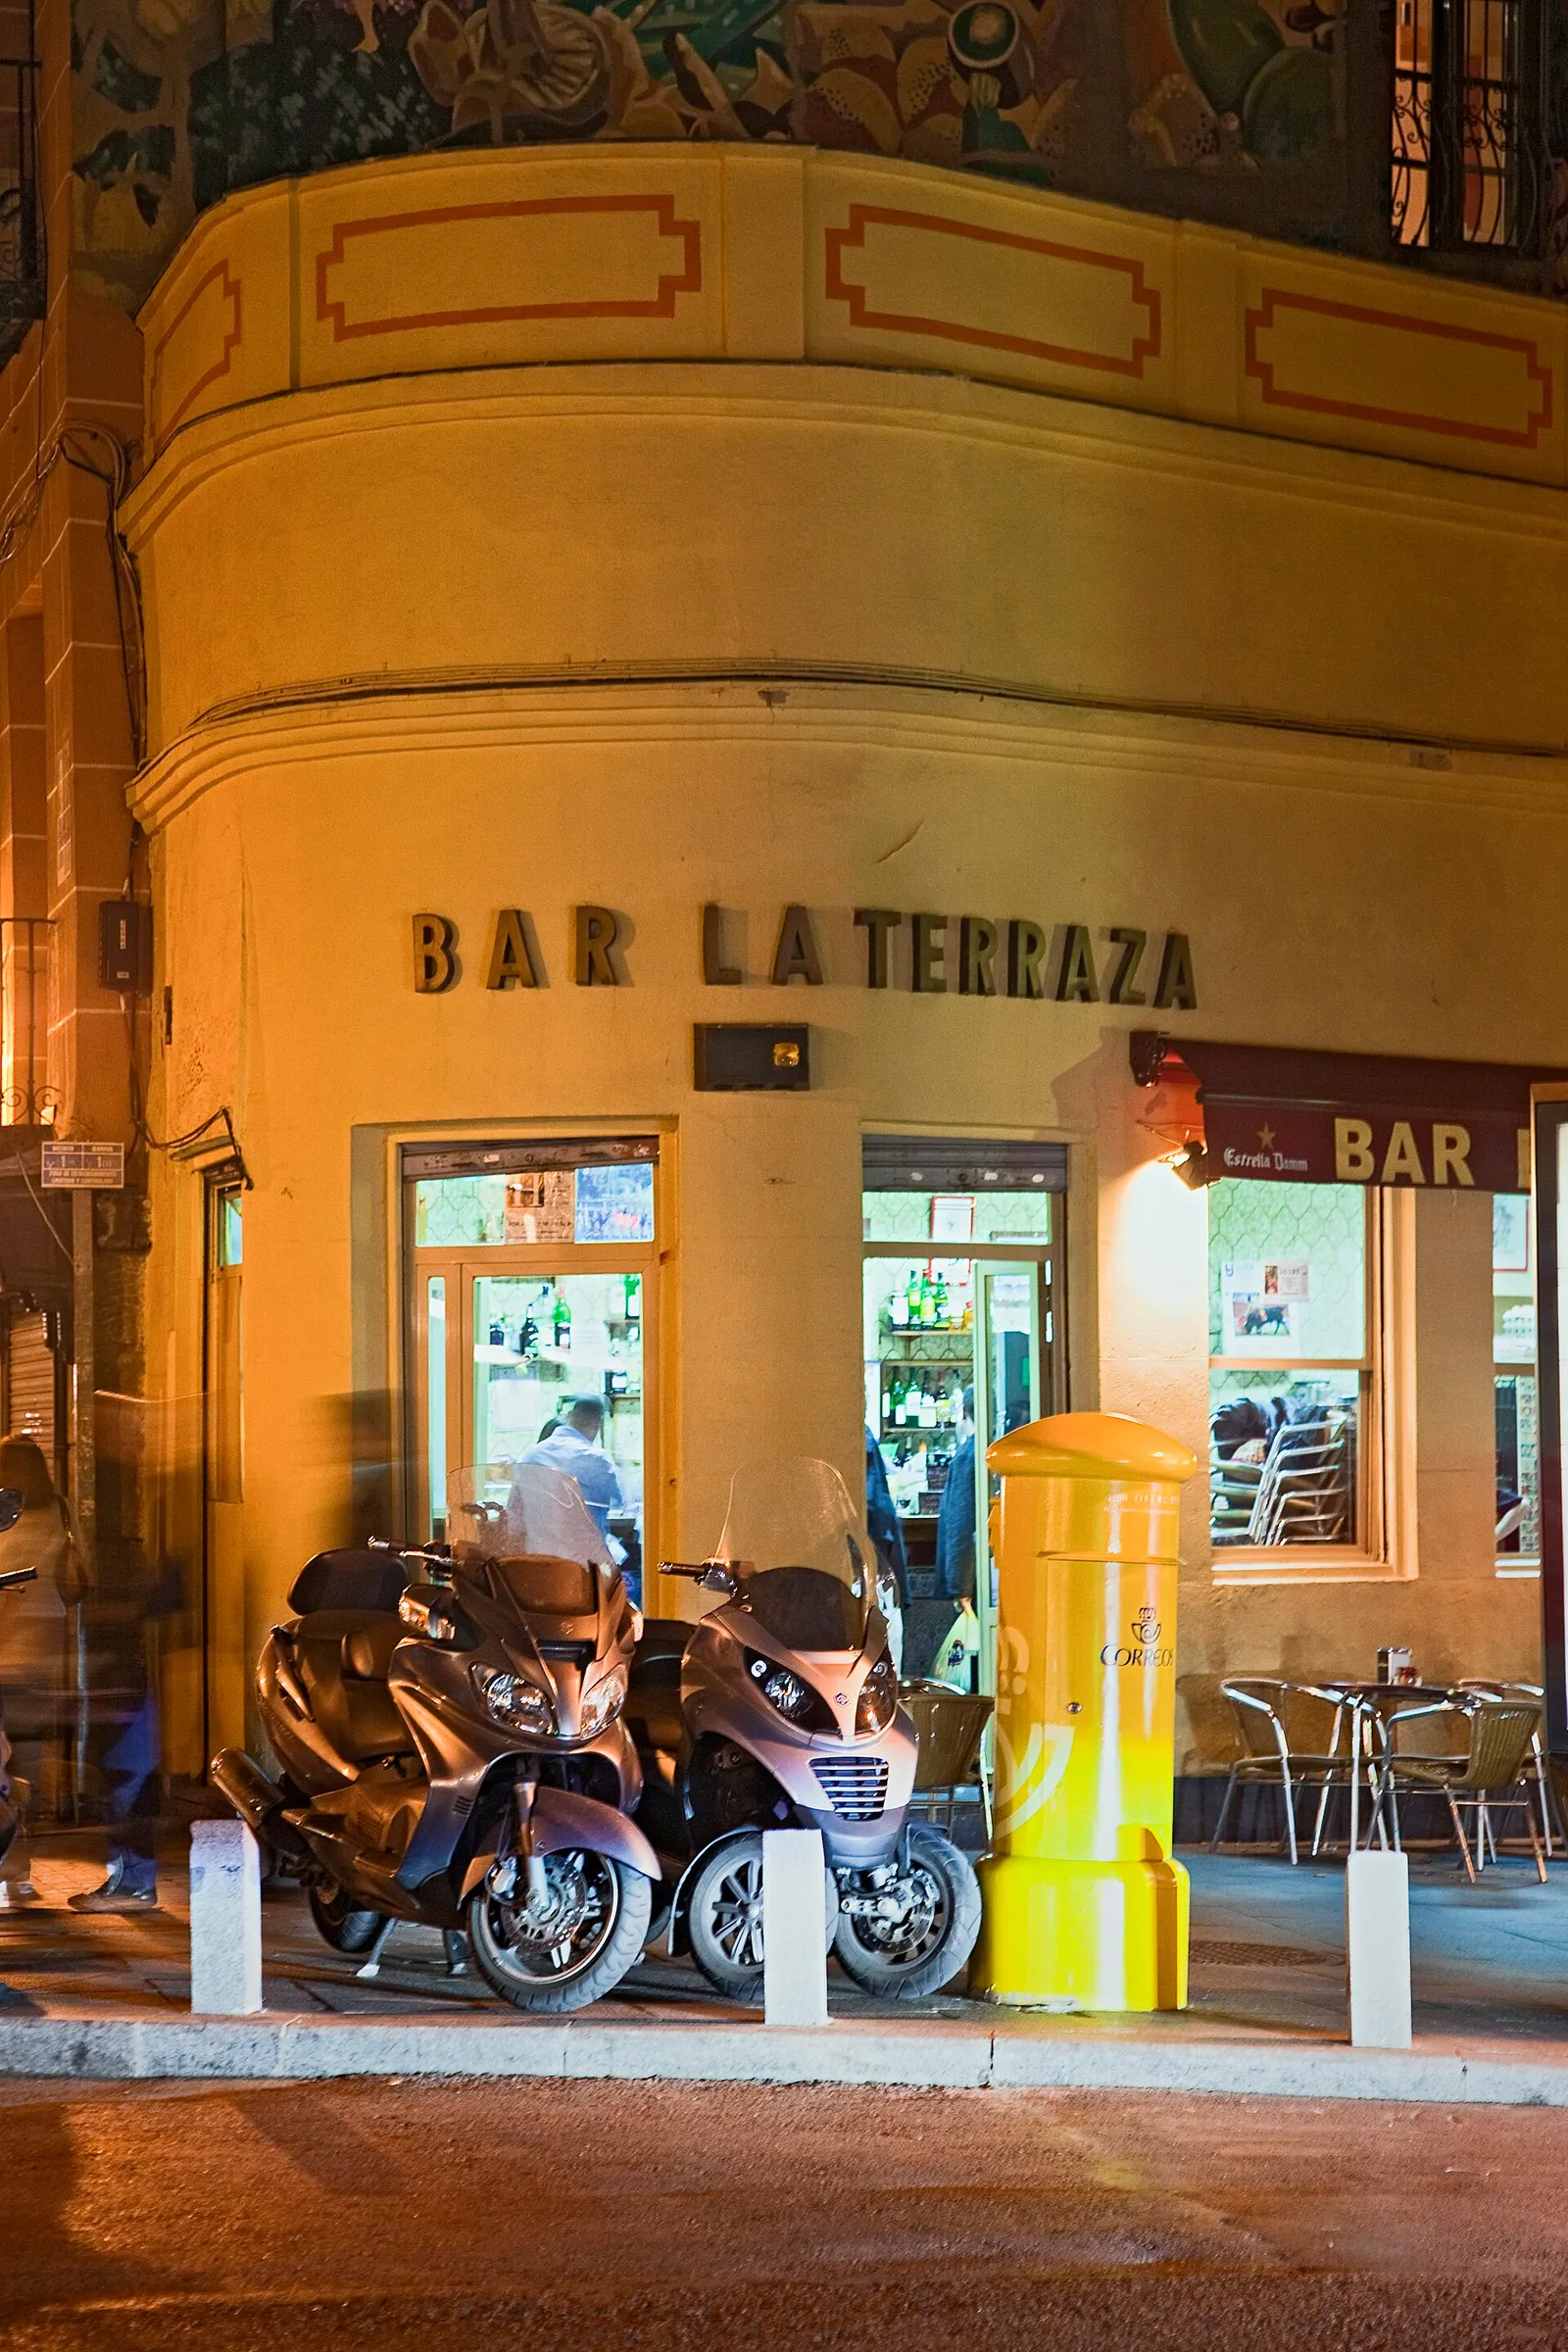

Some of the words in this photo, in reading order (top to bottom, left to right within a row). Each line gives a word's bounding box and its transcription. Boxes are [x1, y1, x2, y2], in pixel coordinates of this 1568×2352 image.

[413, 905, 619, 993] BAR
[703, 905, 824, 986] LA
[854, 907, 1198, 1009] TERRAZA
[1223, 1147, 1271, 1168] Estrella
[1273, 1152, 1308, 1171] Damm
[1335, 1118, 1475, 1186] BAR
[1101, 1643, 1173, 1667] CORREOS
